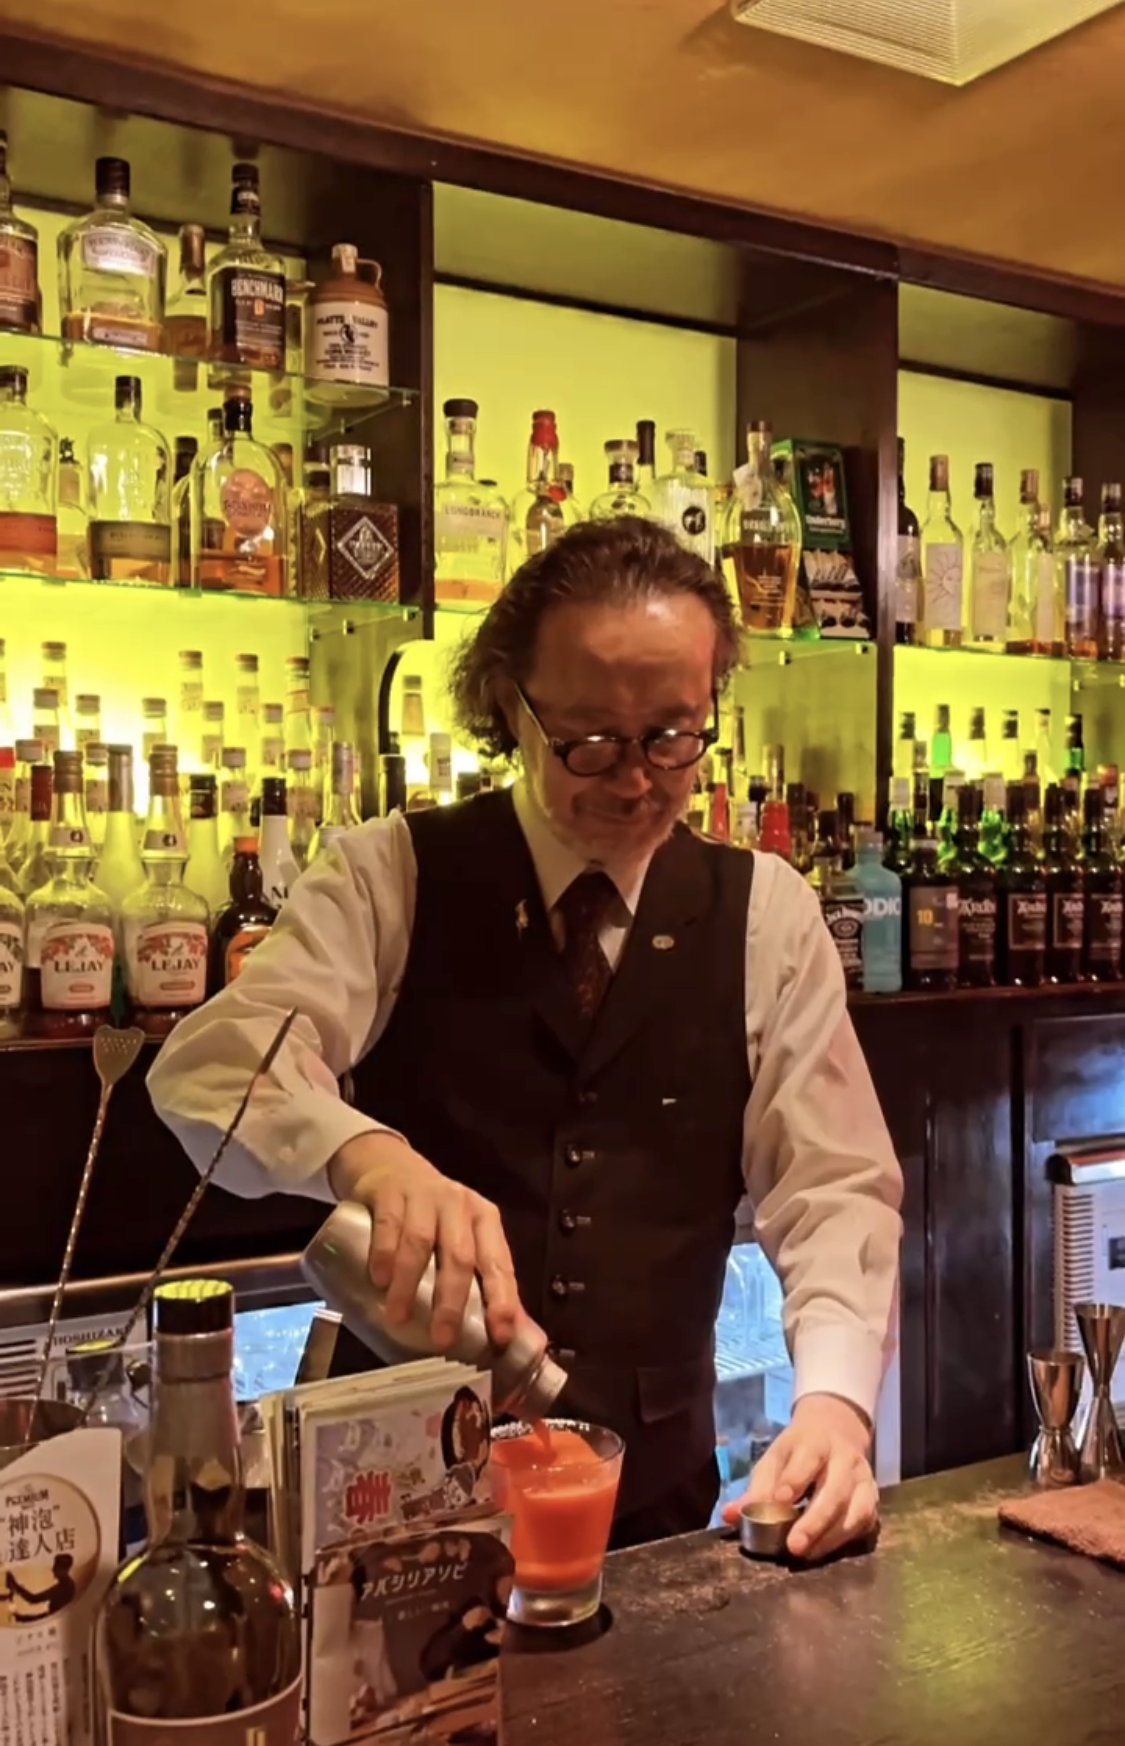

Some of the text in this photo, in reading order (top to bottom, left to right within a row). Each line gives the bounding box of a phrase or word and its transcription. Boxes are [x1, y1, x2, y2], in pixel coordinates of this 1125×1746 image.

[231, 279, 284, 303] BENCHMARK
[917, 909, 933, 925] 10
[54, 959, 104, 973] LEJAY
[151, 957, 201, 972] LEJAY
[54, 1327, 127, 1346] HOSHIZAK
[0, 1527, 76, 1563] 達人店
